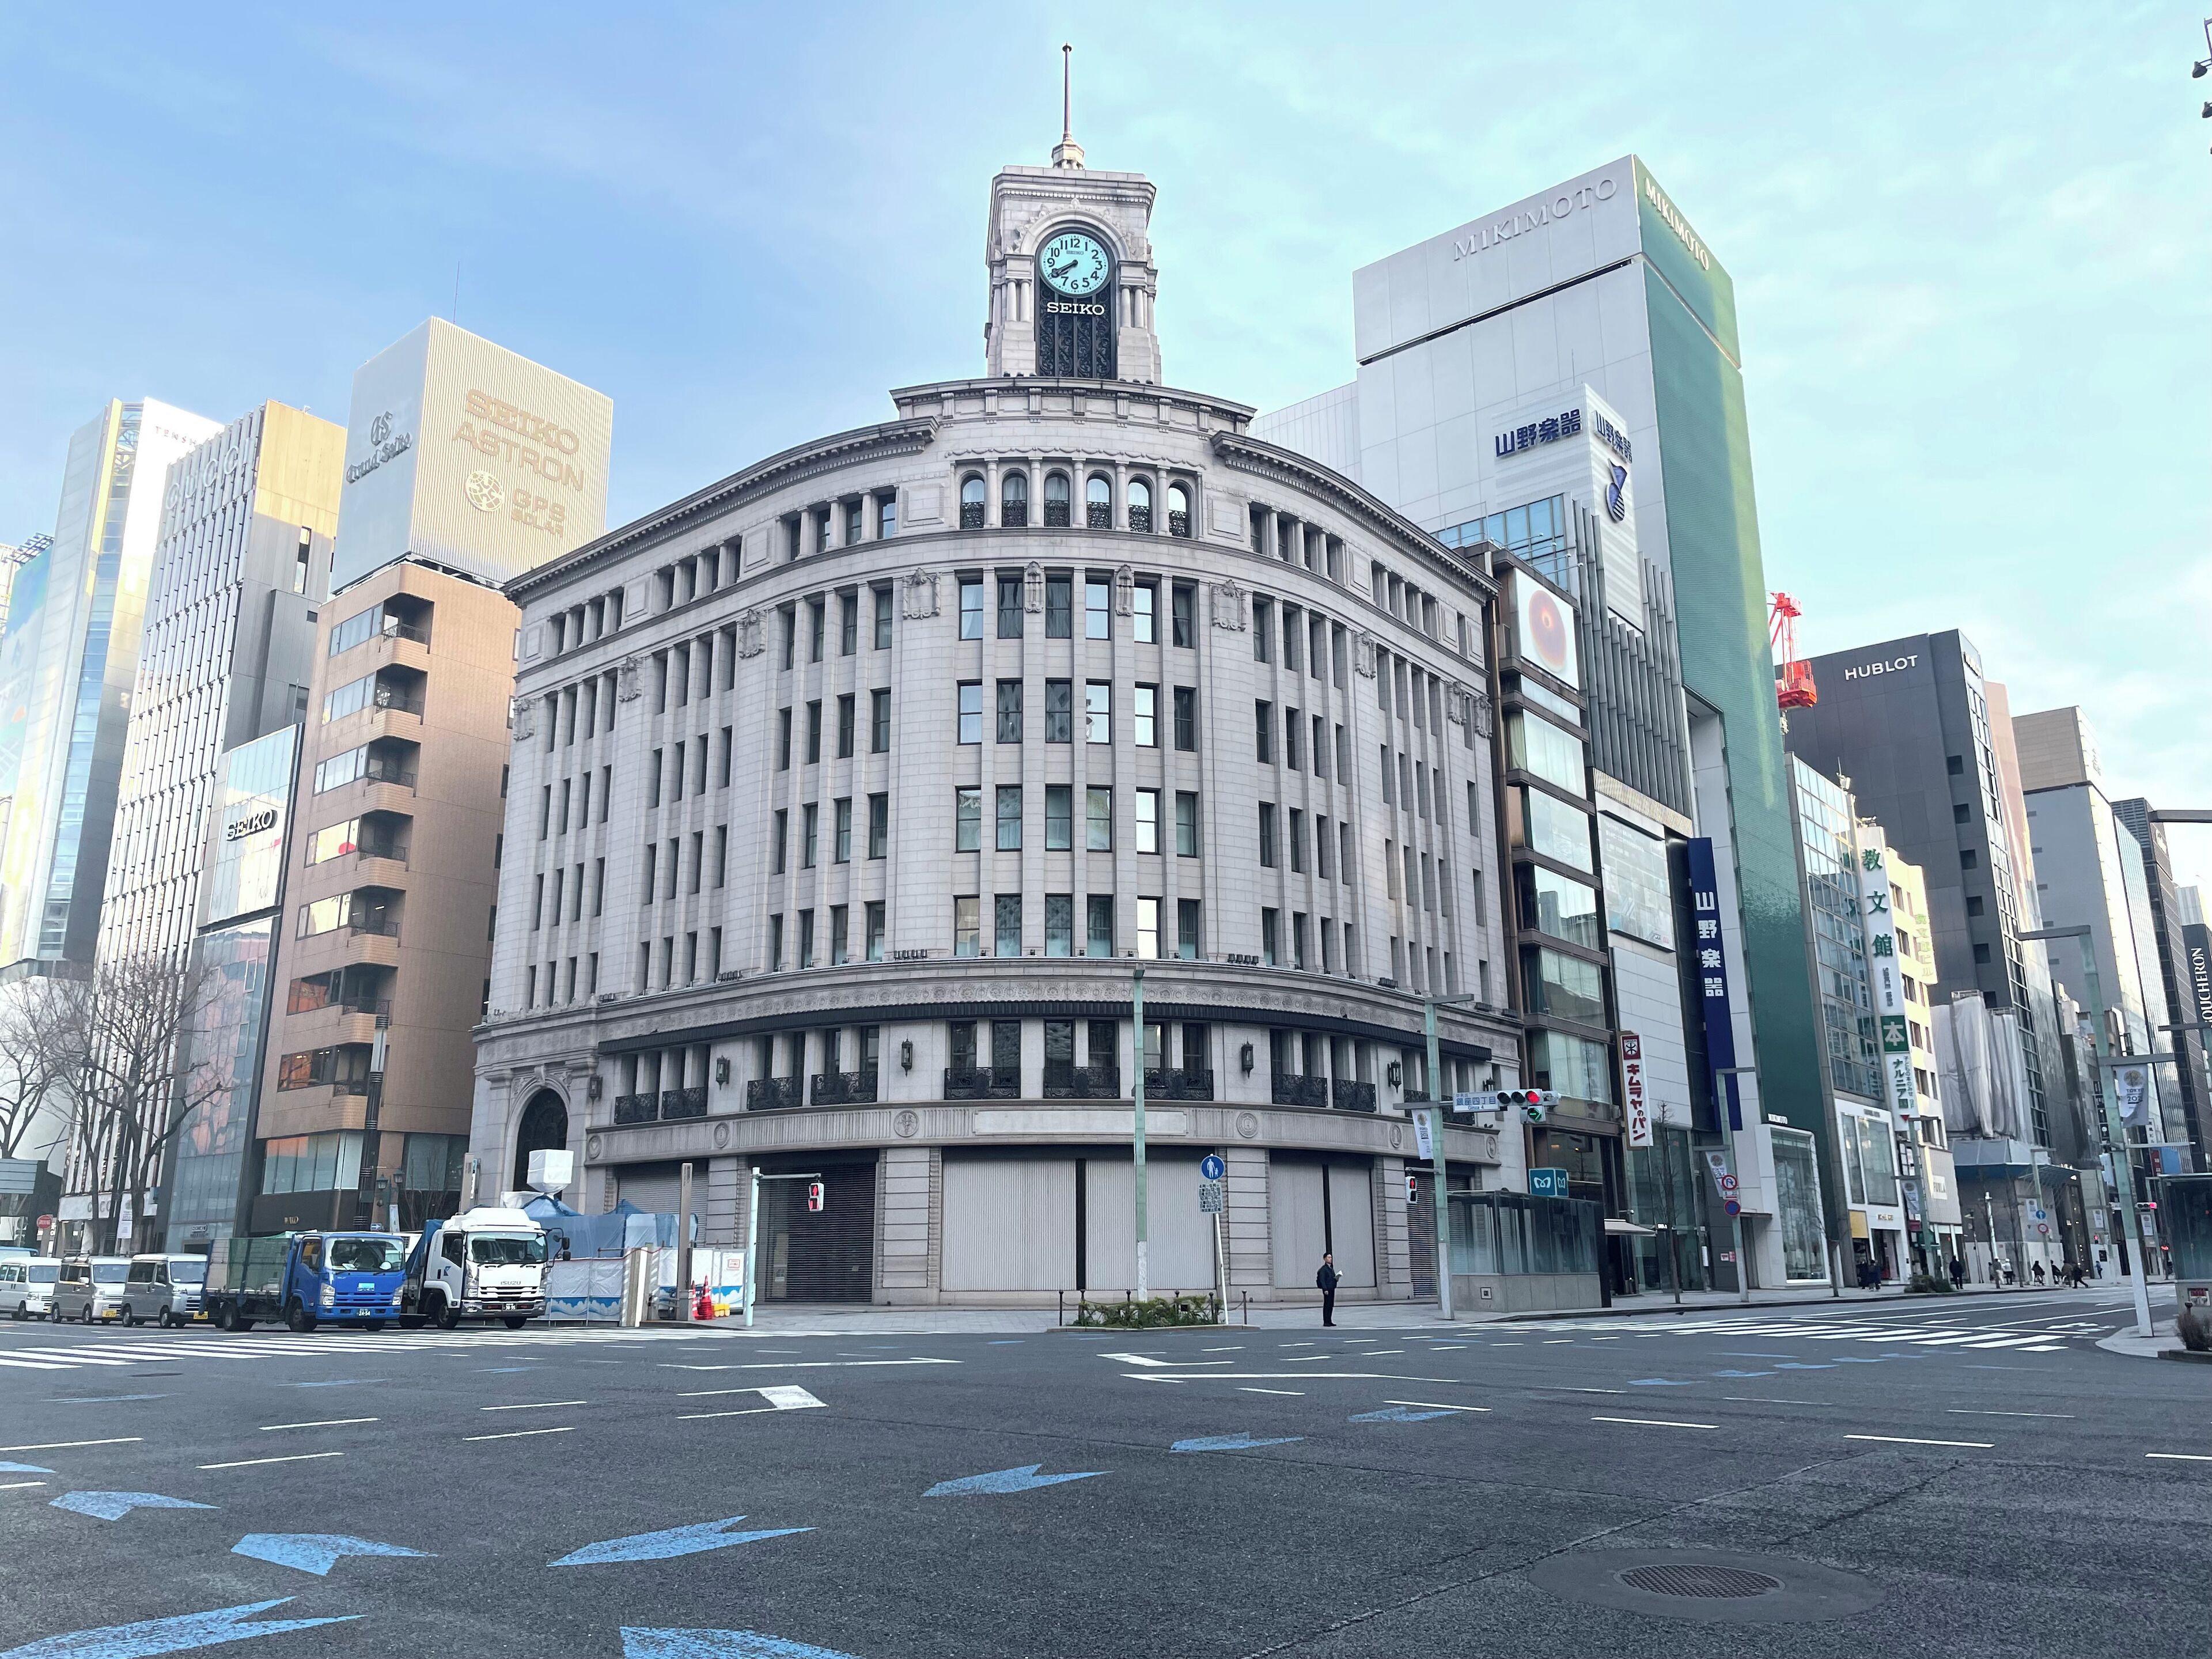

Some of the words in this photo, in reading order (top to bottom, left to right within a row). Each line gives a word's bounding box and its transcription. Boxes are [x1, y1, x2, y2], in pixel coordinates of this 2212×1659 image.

[1453, 179, 1617, 261] MIKIMOTO
[1645, 177, 1709, 271] MIKIMOTO
[1051, 248, 1060, 257] 10
[1060, 240, 1067, 249] 11
[1071, 238, 1080, 248] 12
[1091, 249, 1099, 259] 2
[1047, 258, 1055, 267] 9
[1090, 271, 1099, 281] 4
[1095, 260, 1103, 270] 3
[1061, 276, 1069, 286] 7
[1071, 280, 1078, 289] 6
[1082, 278, 1089, 287] 5
[1047, 302, 1105, 316] SEIKO
[466, 389, 579, 454] SEIKO
[1495, 408, 1582, 457] 山野楽器
[1596, 410, 1633, 464] 山野楽器
[452, 421, 584, 491] ASTRON
[166, 437, 252, 510] GUCCI
[512, 488, 566, 522] GPS
[511, 507, 564, 537] SOLAR
[1844, 654, 1918, 681] HUBLOT
[226, 809, 276, 841] SEIKO
[1861, 849, 1893, 958] 教文館
[1695, 892, 1724, 997] 山野楽器
[1883, 1021, 1905, 1046] 本
[1456, 1096, 1496, 1105] 銀座四丁目
[1627, 1064, 1646, 1141] キムラヤのパン
